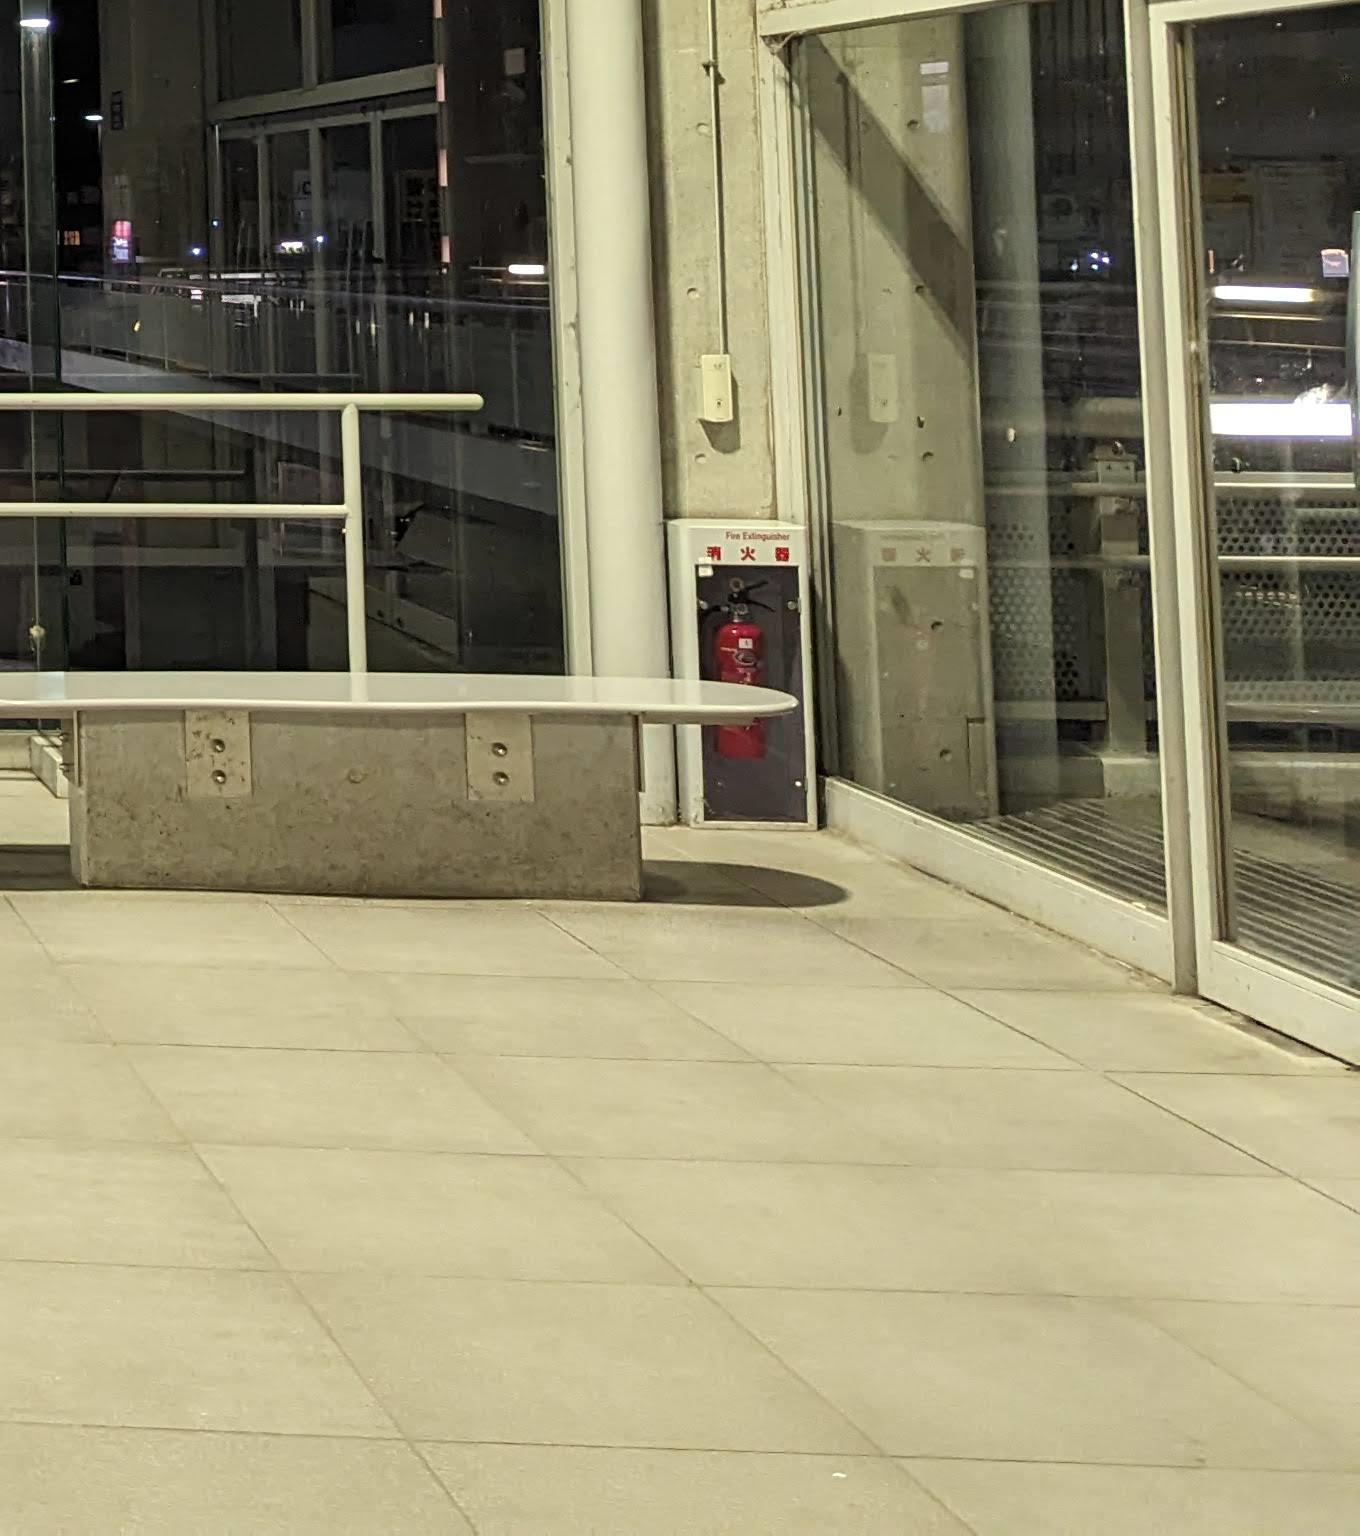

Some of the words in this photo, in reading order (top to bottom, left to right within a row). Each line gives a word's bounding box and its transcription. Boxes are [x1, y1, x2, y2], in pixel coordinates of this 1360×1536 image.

[726, 531, 741, 540] Fire
[742, 531, 790, 542] Extinguisher
[706, 546, 790, 562] 消火器
